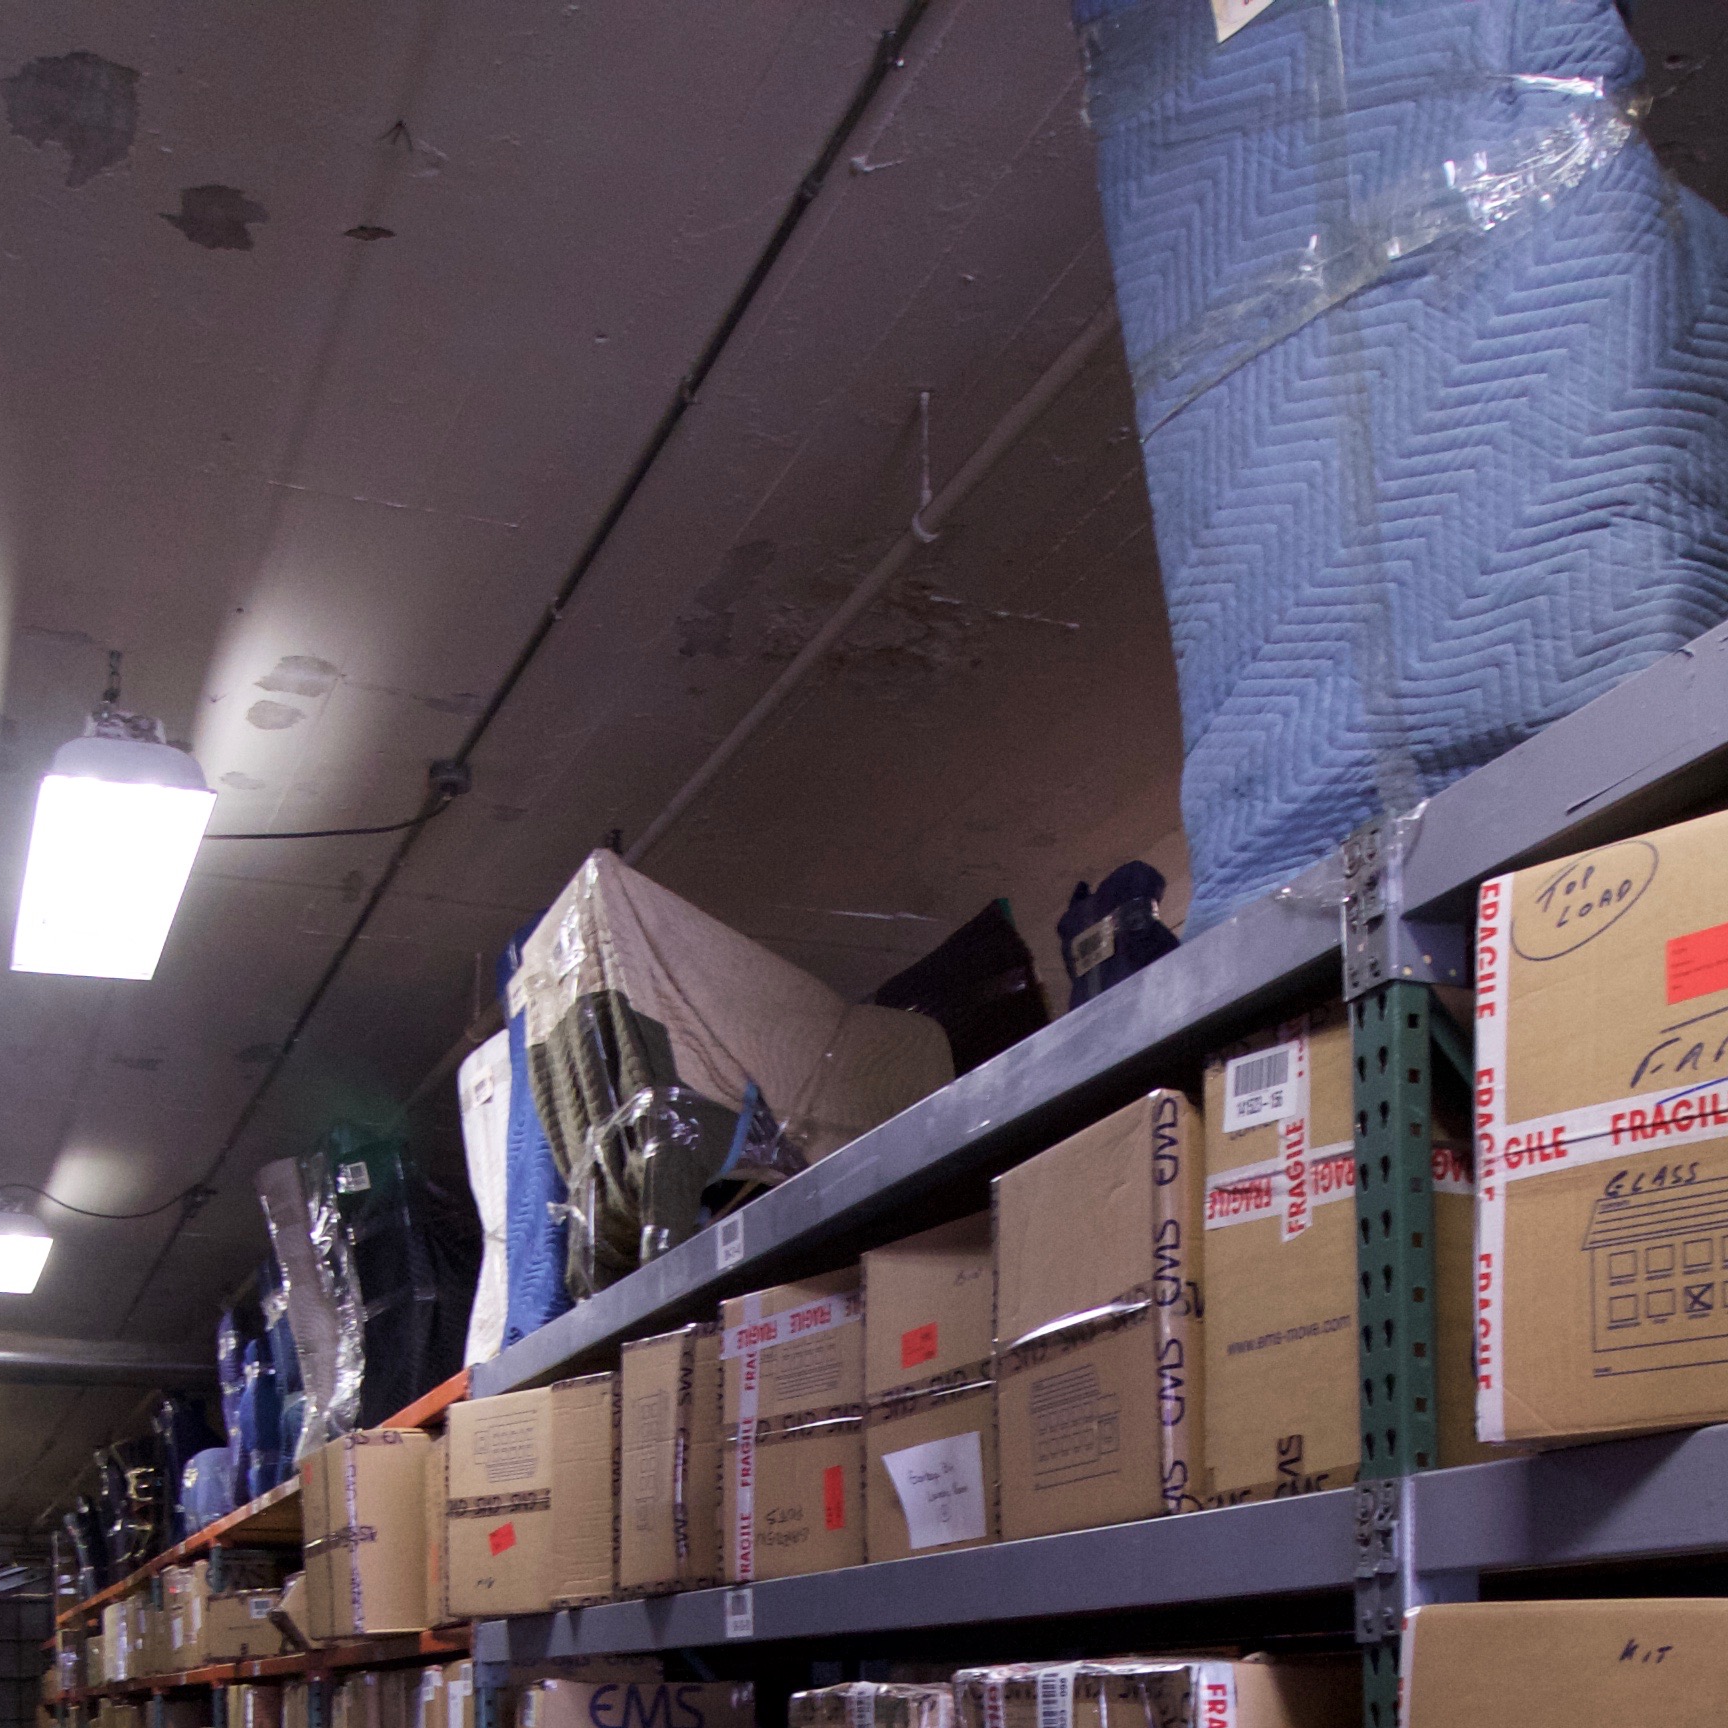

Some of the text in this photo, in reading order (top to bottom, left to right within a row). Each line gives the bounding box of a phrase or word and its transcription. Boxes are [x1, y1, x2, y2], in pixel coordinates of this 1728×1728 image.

[1534, 864, 1596, 913] TOP
[1555, 877, 1634, 929] LOAD
[1152, 1096, 1180, 1187] EMS
[1285, 1116, 1306, 1234] FRAGILE
[1206, 1176, 1273, 1221] FRAGILE
[1605, 1161, 1700, 1200] GLASS
[1152, 1217, 1182, 1308] EMS
[1156, 1337, 1186, 1427] EMS
